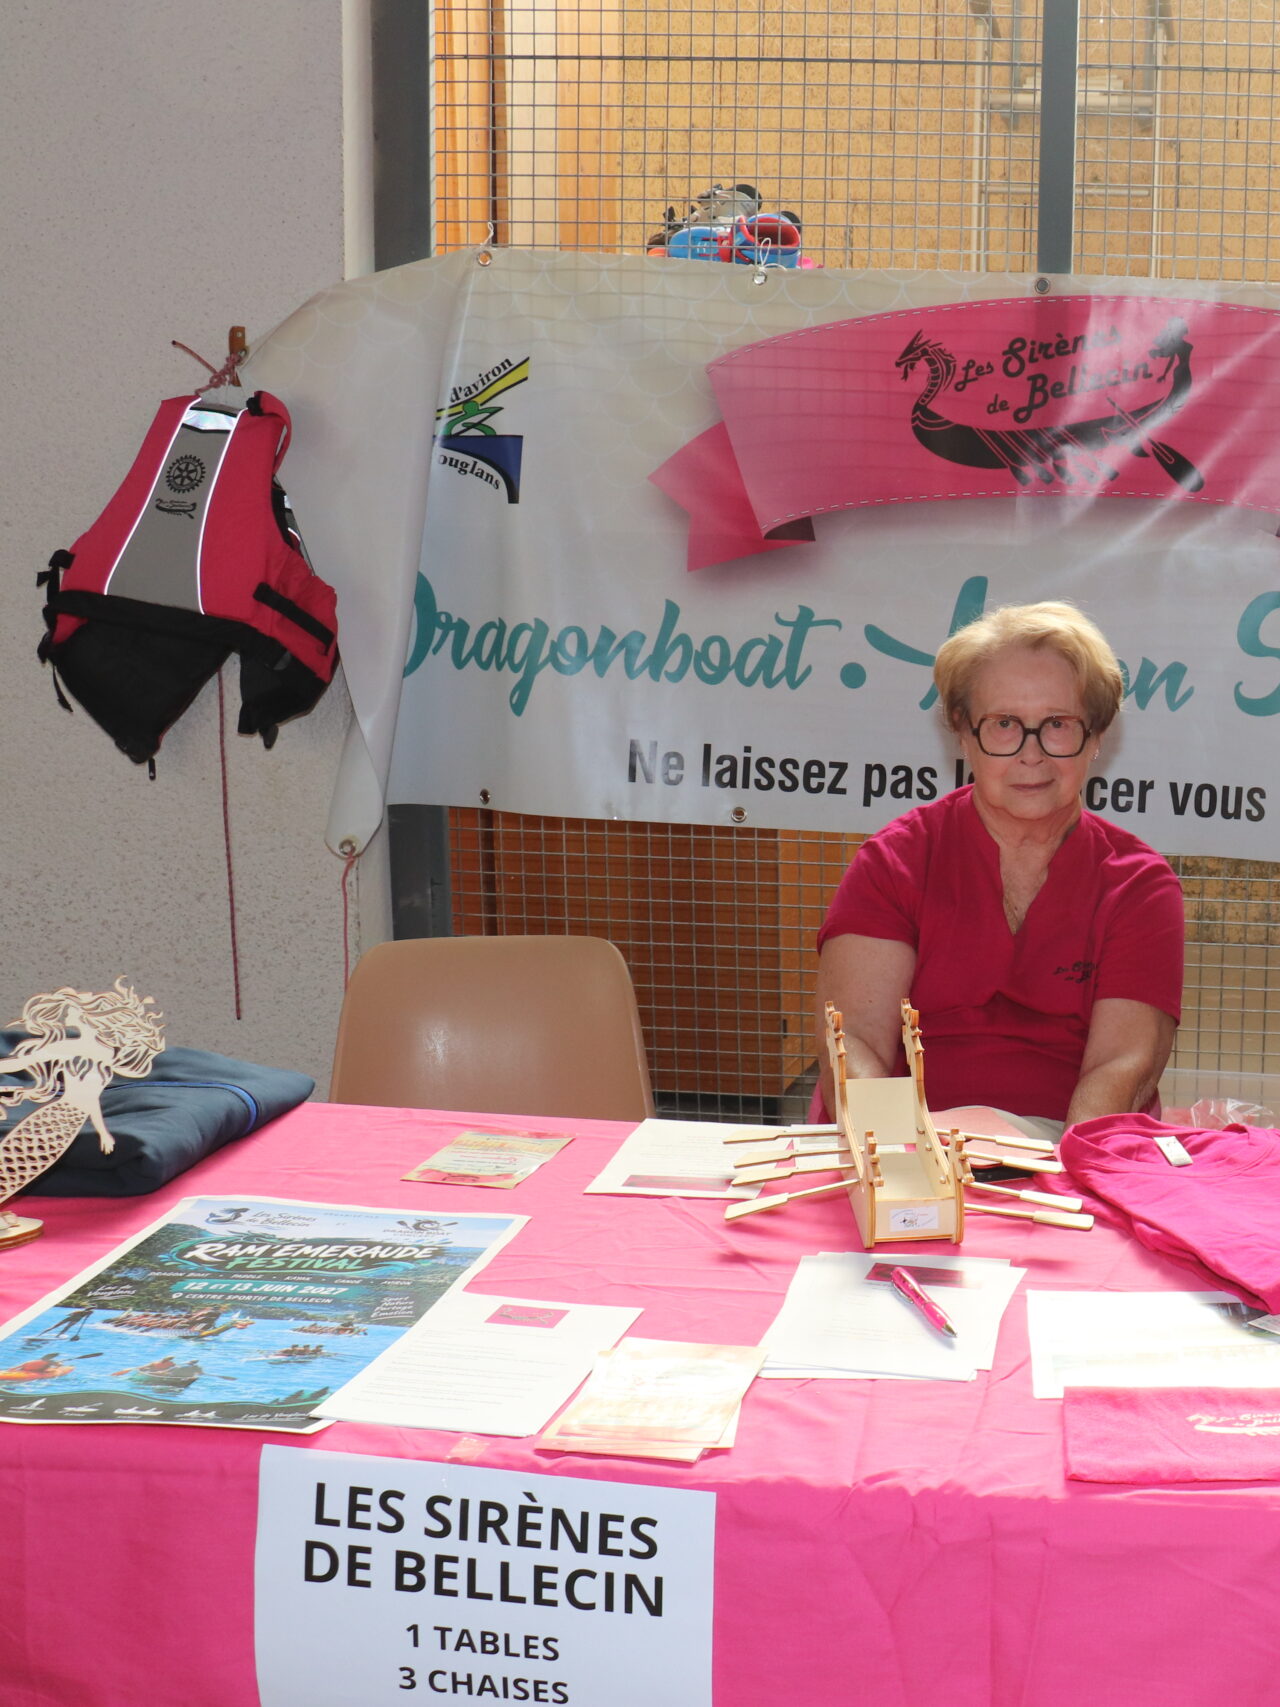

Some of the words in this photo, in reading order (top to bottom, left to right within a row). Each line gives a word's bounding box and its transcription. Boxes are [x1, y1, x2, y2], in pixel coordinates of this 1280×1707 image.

[449, 356, 515, 403] d'aviron
[956, 360, 995, 391] Les
[986, 394, 1009, 415] de
[1014, 361, 1153, 422] Bellecin
[437, 453, 501, 491] ouglans
[627, 739, 685, 789] Ne
[701, 744, 848, 795] laissez
[863, 761, 938, 806] pas
[1086, 775, 1155, 813] cer
[1169, 781, 1266, 822] vous
[225, 1257, 365, 1271] FESTIVAL
[183, 1282, 209, 1290] 12
[230, 1283, 254, 1291] 13
[252, 1283, 298, 1293] JUIN
[314, 1482, 406, 1534] LES
[424, 1491, 659, 1560] SIRÈNES
[304, 1539, 372, 1589] DE
[394, 1549, 664, 1618] BELLECIN
[406, 1623, 420, 1649] 1
[433, 1626, 560, 1661] TABLES
[398, 1666, 417, 1691] 3
[428, 1670, 569, 1705] CHAISES
